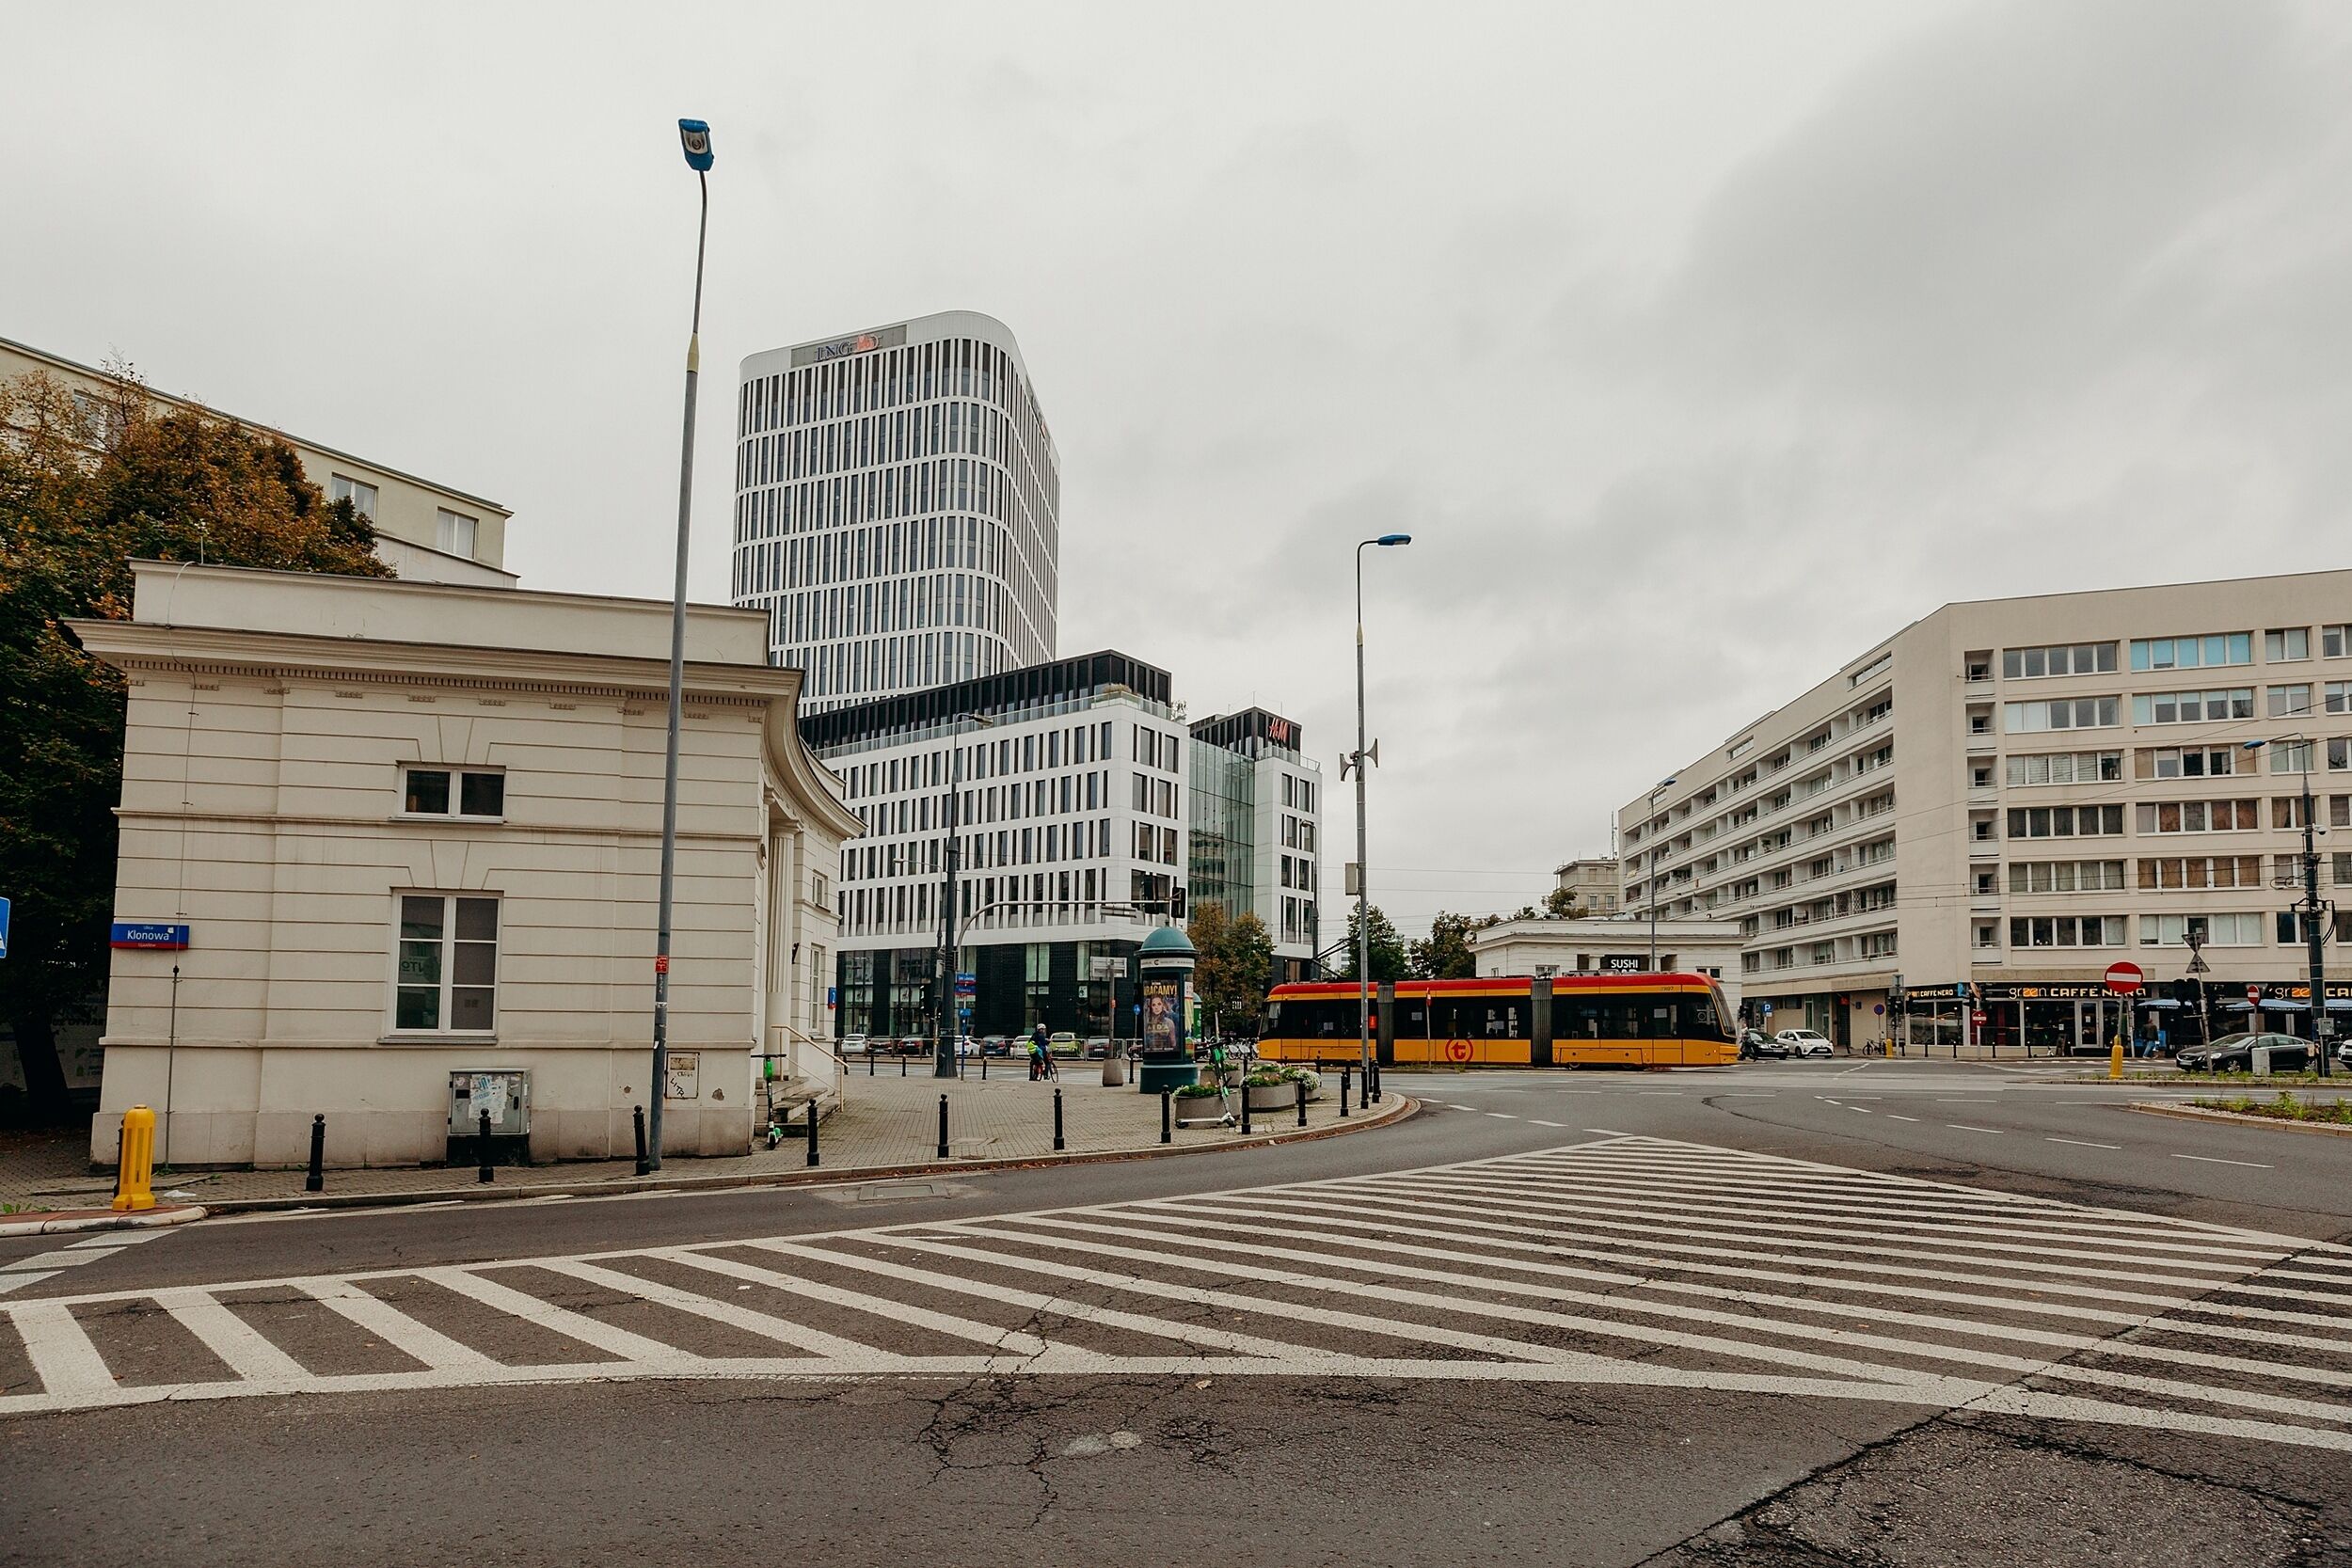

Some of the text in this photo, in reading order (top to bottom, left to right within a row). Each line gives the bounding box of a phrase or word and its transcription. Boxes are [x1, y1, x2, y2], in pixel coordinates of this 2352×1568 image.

[815, 341, 853, 361] ING
[1268, 717, 1289, 743] H&M
[127, 929, 169, 941] Klonowa
[1610, 958, 1639, 969] SUSHI
[2009, 987, 2047, 1000] green
[2274, 987, 2352, 1000] gree CA
[1764, 1004, 1771, 1012] P
